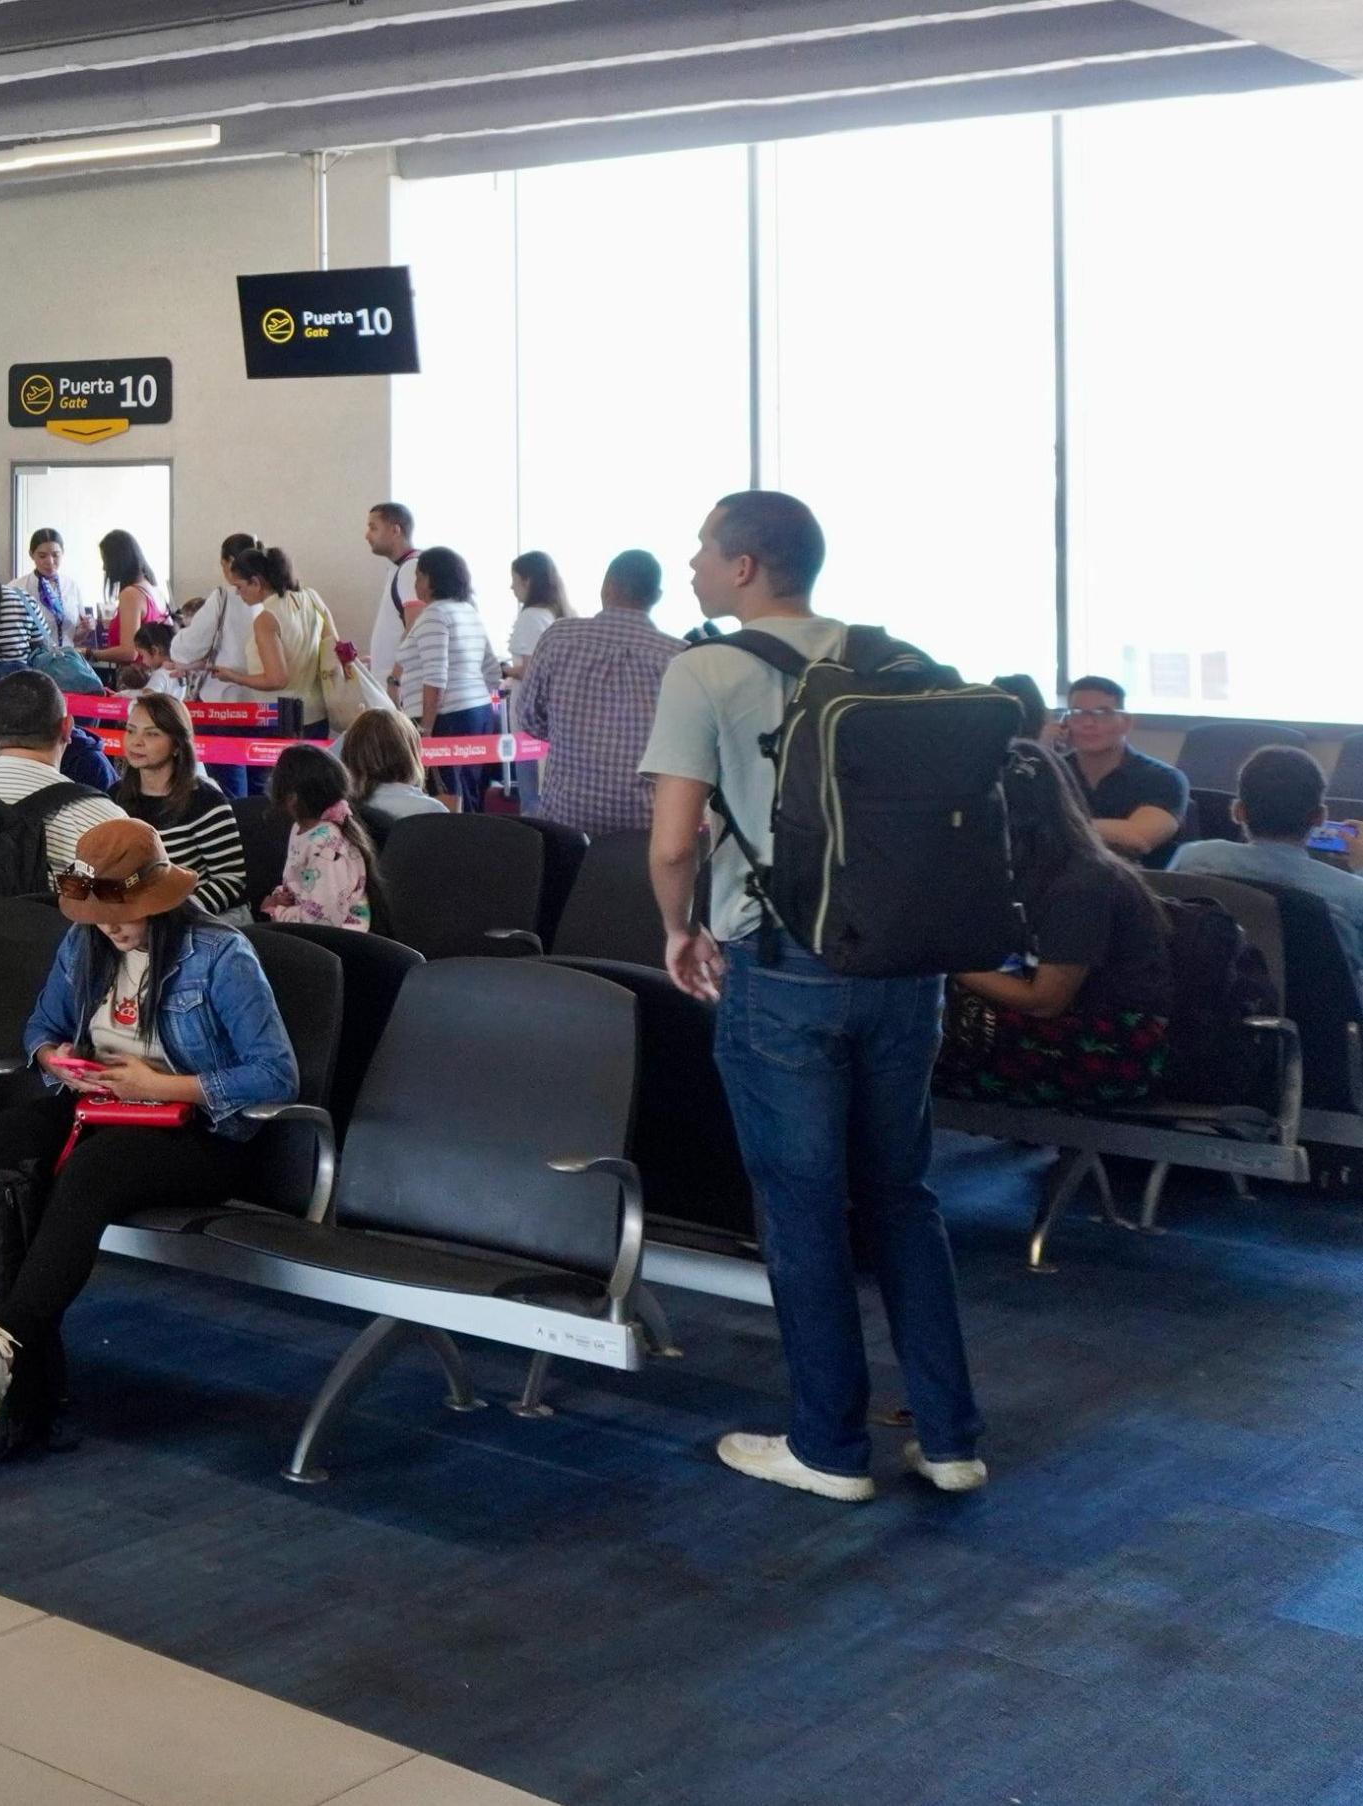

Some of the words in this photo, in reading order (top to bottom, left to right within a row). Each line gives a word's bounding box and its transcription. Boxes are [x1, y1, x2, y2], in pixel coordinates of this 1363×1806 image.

[303, 311, 354, 325] Puerta
[356, 307, 393, 336] 10
[304, 328, 330, 338] Gate
[59, 378, 115, 395] Puerta
[120, 374, 158, 408] 10
[59, 397, 89, 409] Gate
[208, 708, 248, 719] Inglesa
